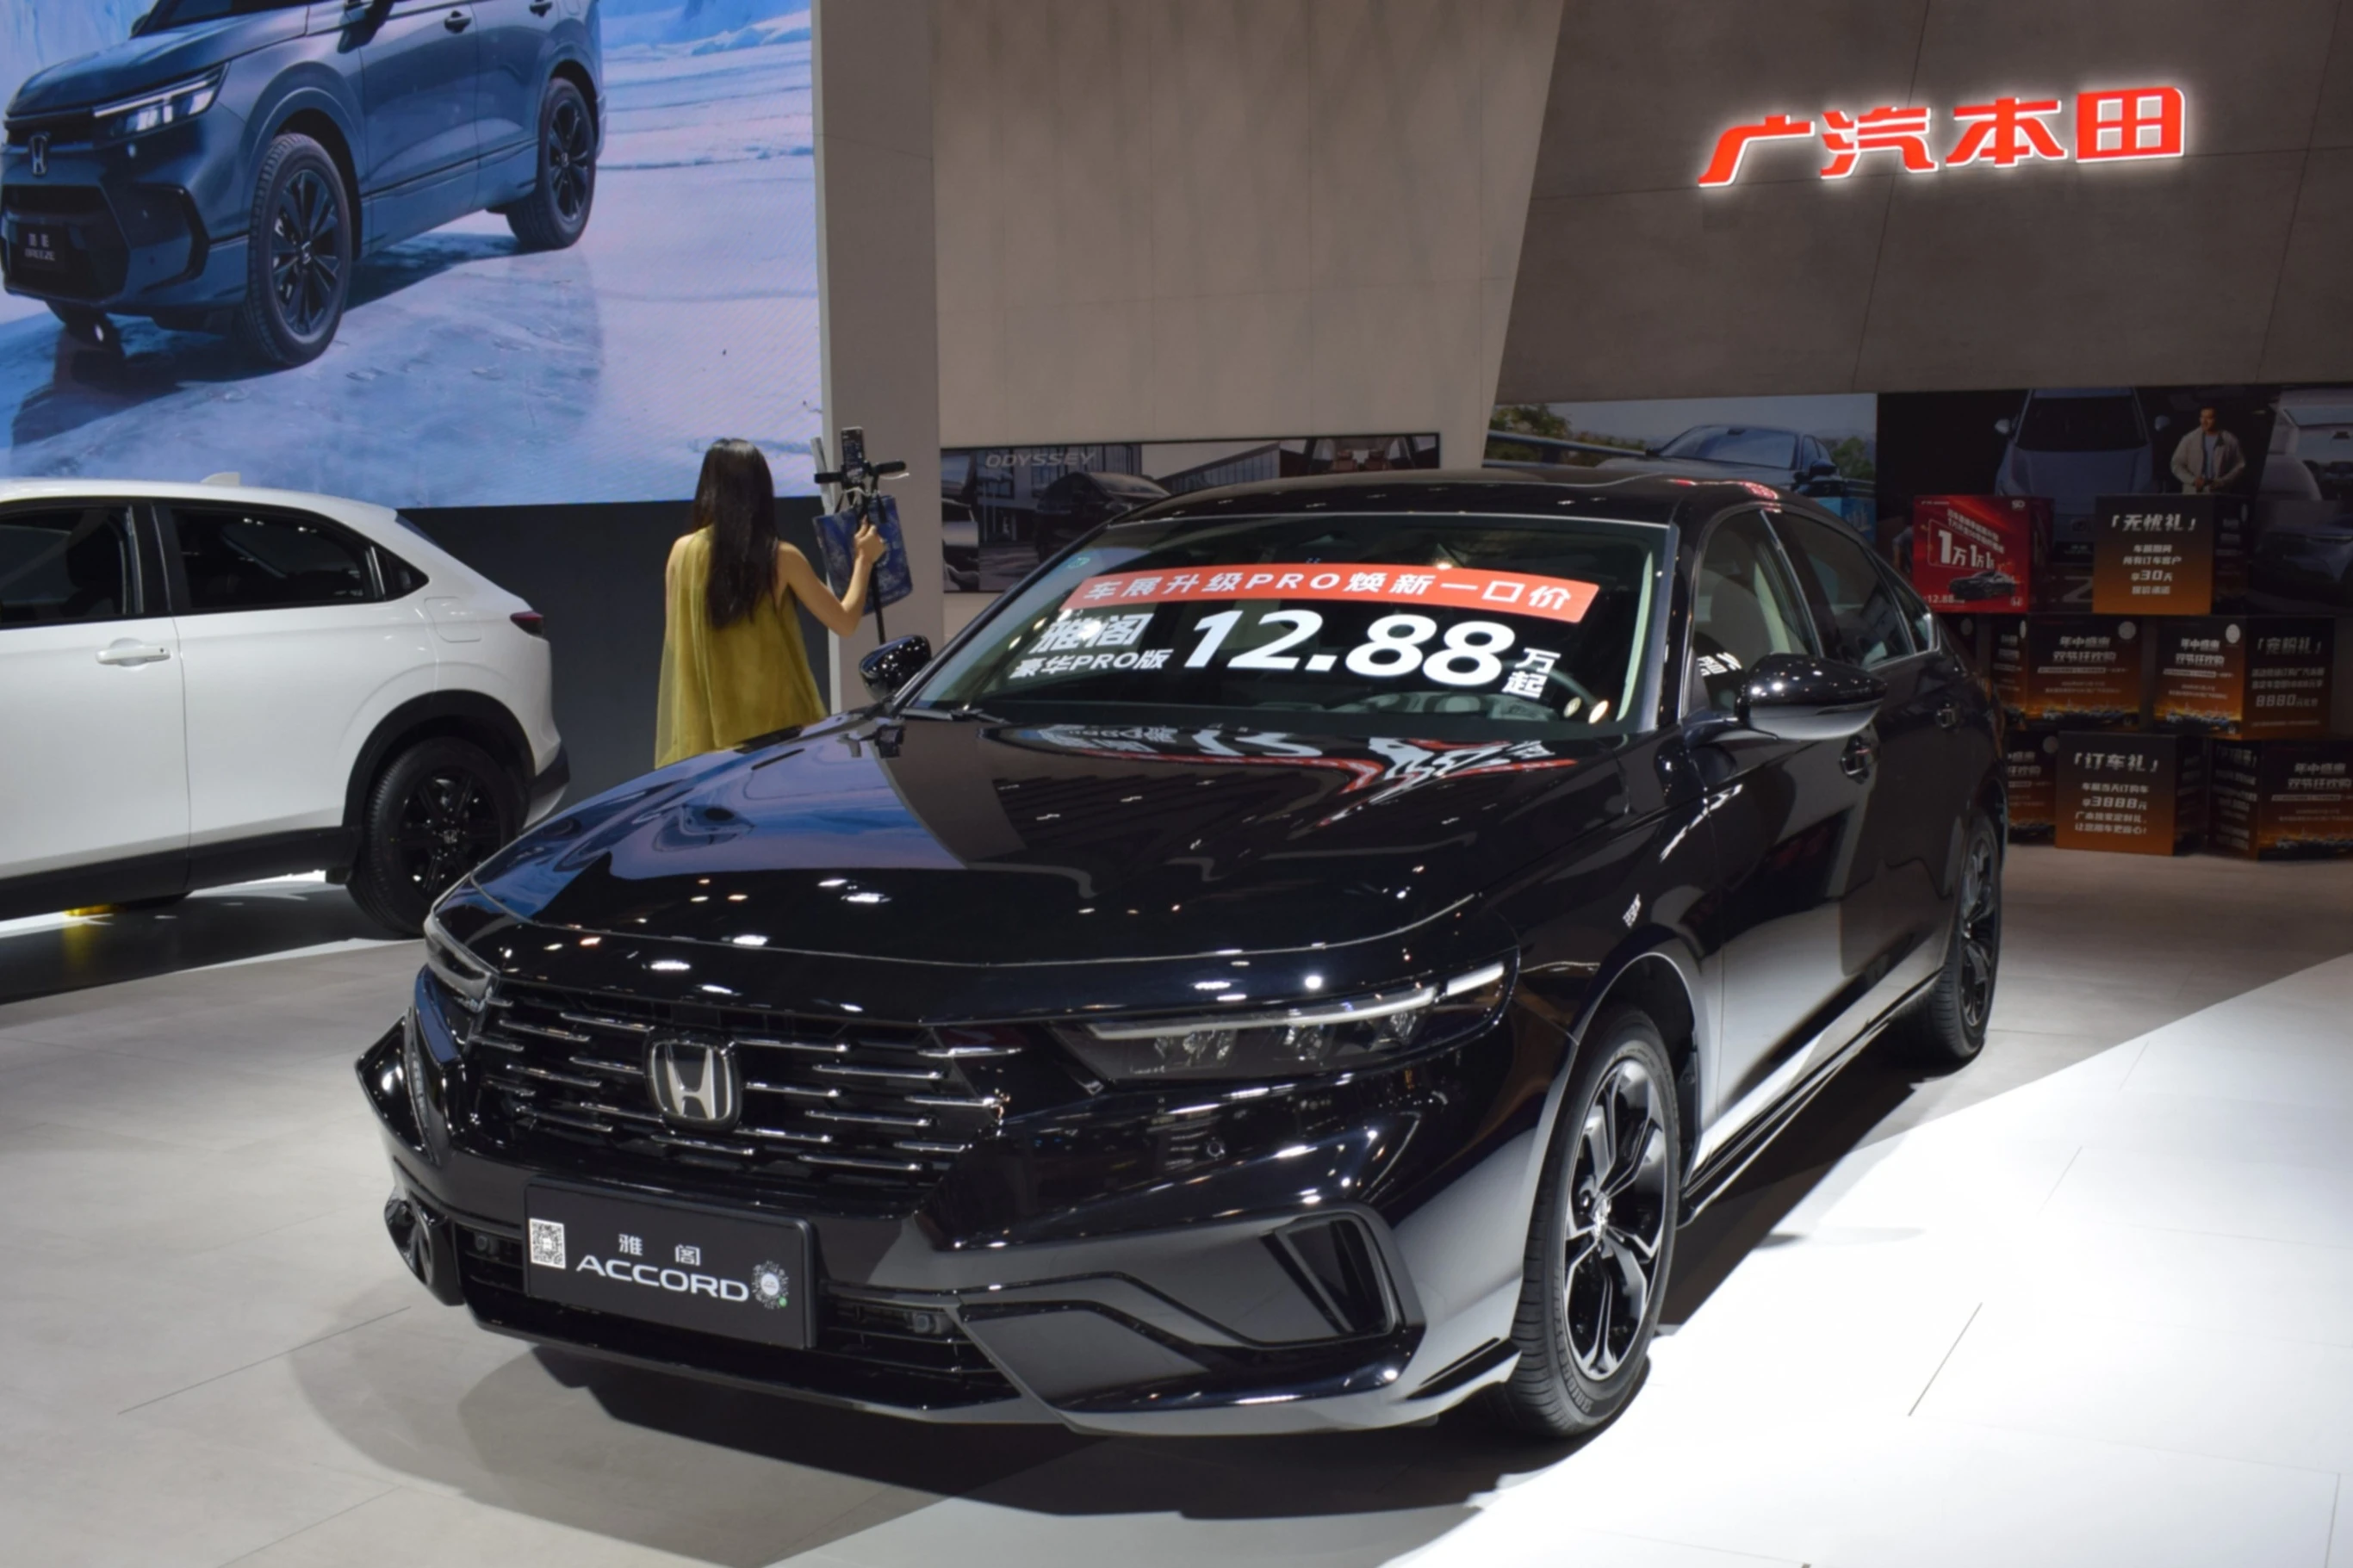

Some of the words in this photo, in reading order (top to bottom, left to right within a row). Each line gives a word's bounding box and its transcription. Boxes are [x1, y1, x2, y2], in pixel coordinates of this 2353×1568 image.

[1698, 88, 2185, 187] 广汽本田
[985, 450, 1096, 468] ODYSSEY
[1083, 572, 1572, 610] 车展升级PRO焕新一口价
[1027, 613, 1155, 654] 雅阁
[1184, 609, 1516, 686] 12.88
[1009, 648, 1174, 679] 豪华PRO版
[575, 1255, 748, 1303] ACCORD
